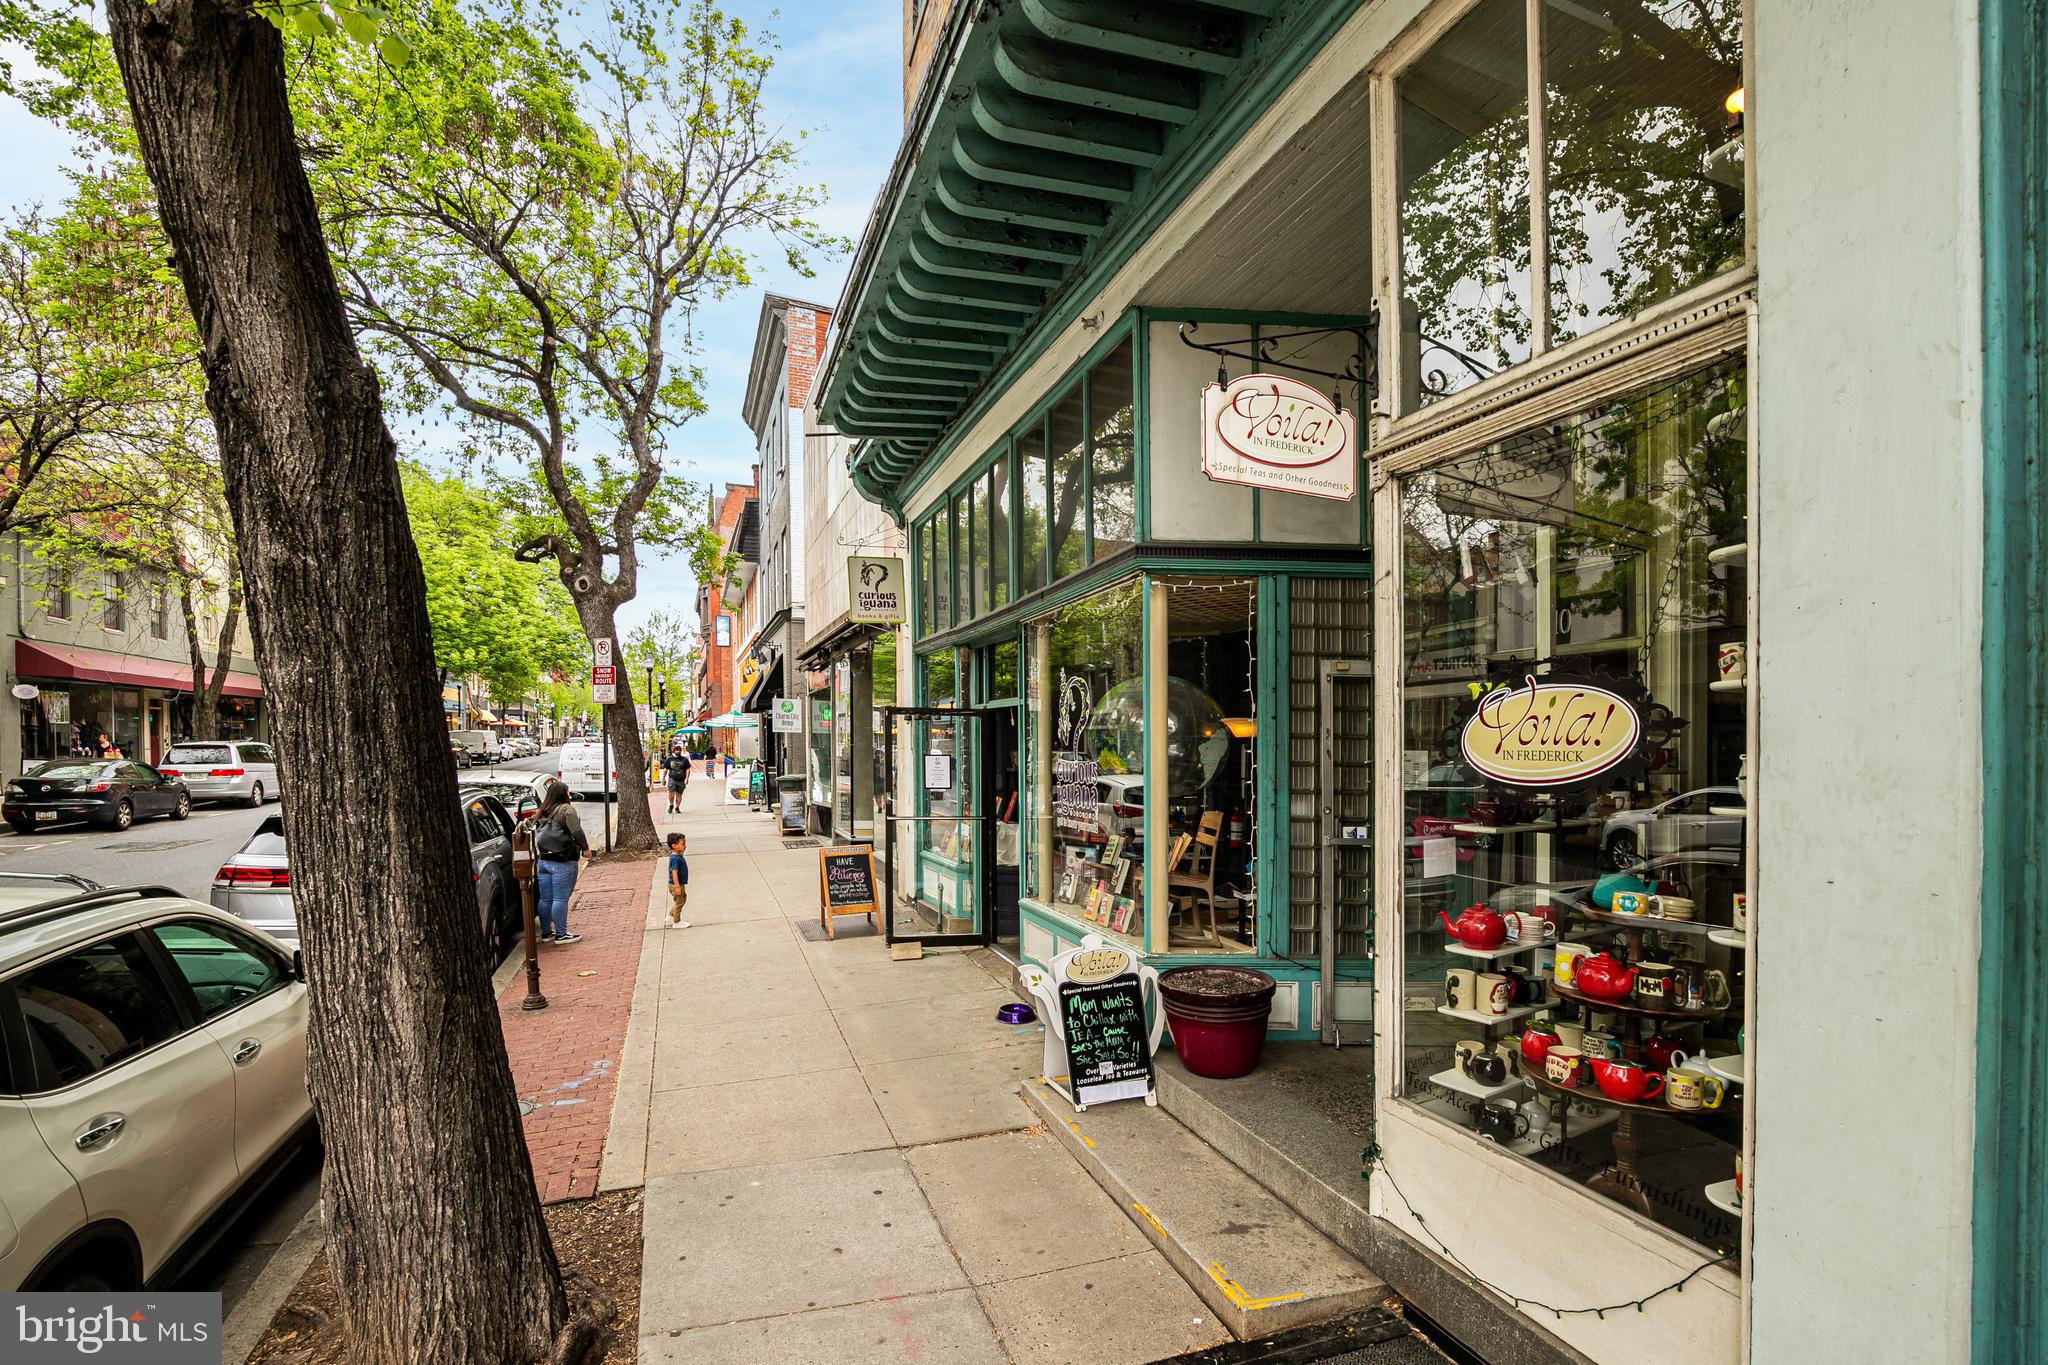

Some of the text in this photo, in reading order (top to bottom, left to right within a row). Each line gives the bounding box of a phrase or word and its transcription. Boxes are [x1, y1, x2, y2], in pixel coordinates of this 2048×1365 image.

[1233, 384, 1333, 446] Voila!
[1253, 437, 1314, 455] IN FREDERICK
[1218, 462, 1343, 491] Special Teas and Other Goodness
[858, 592, 897, 600] curious
[859, 600, 897, 611] iguana
[1479, 674, 1615, 755] Voila!
[1502, 750, 1585, 762] IN FREDERICK
[1057, 761, 1098, 786] curious
[1057, 781, 1098, 815] iguana
[836, 857, 854, 866] HAVE
[1617, 896, 1639, 907] TEA
[1066, 986, 1082, 995] Special
[1113, 980, 1133, 988] Goodness
[1069, 995, 1098, 1015] Mom
[1066, 1016, 1081, 1029] to
[1077, 1074, 1104, 1085] Looseleaf
[1123, 1067, 1147, 1077] Teawares
[1085, 1067, 1099, 1075] Over
[1112, 1061, 1137, 1071] Varieties
[1600, 1160, 1733, 1239] Furnishings
